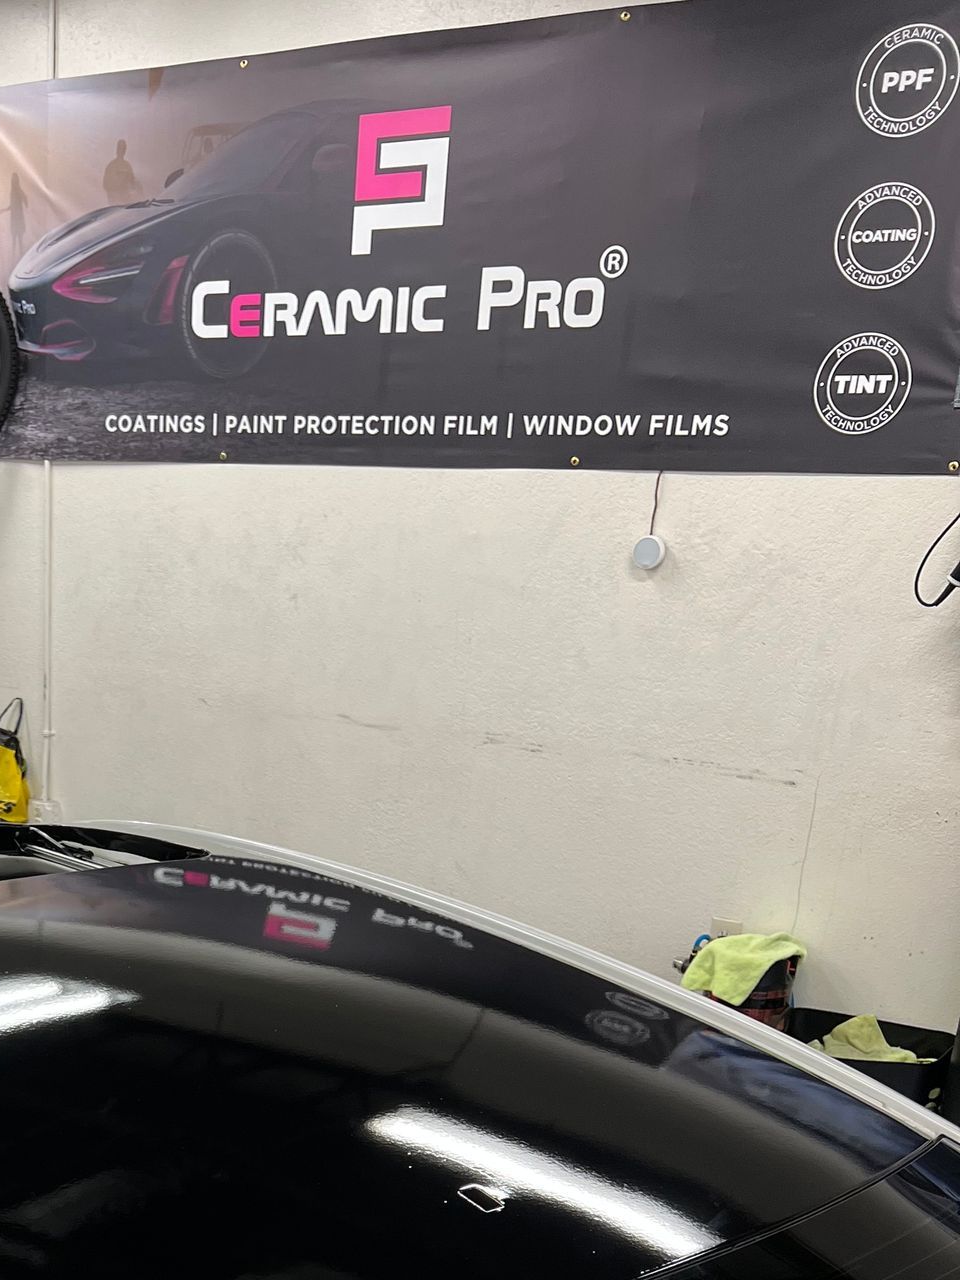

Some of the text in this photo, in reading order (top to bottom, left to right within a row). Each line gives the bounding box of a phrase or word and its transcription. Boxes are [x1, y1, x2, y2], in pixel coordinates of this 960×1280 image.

[884, 27, 944, 48] CERAMIC
[881, 67, 935, 93] PPF
[864, 101, 941, 133] TECHNOLOGY
[857, 186, 923, 210] ADVANCED
[851, 228, 917, 243] COATING
[842, 256, 917, 285] TECHNOLOGY
[191, 280, 447, 339] CERAMIC
[836, 336, 899, 359] ADVANCED
[834, 374, 893, 394] TINT
[105, 414, 206, 434] COATINGS
[225, 415, 288, 434] PAINT
[294, 414, 436, 435] PROTECTION
[443, 415, 499, 435] FILM
[523, 414, 641, 436] WINDOW
[648, 414, 730, 436] FILMS
[822, 404, 894, 431] TECHNOLOGY
